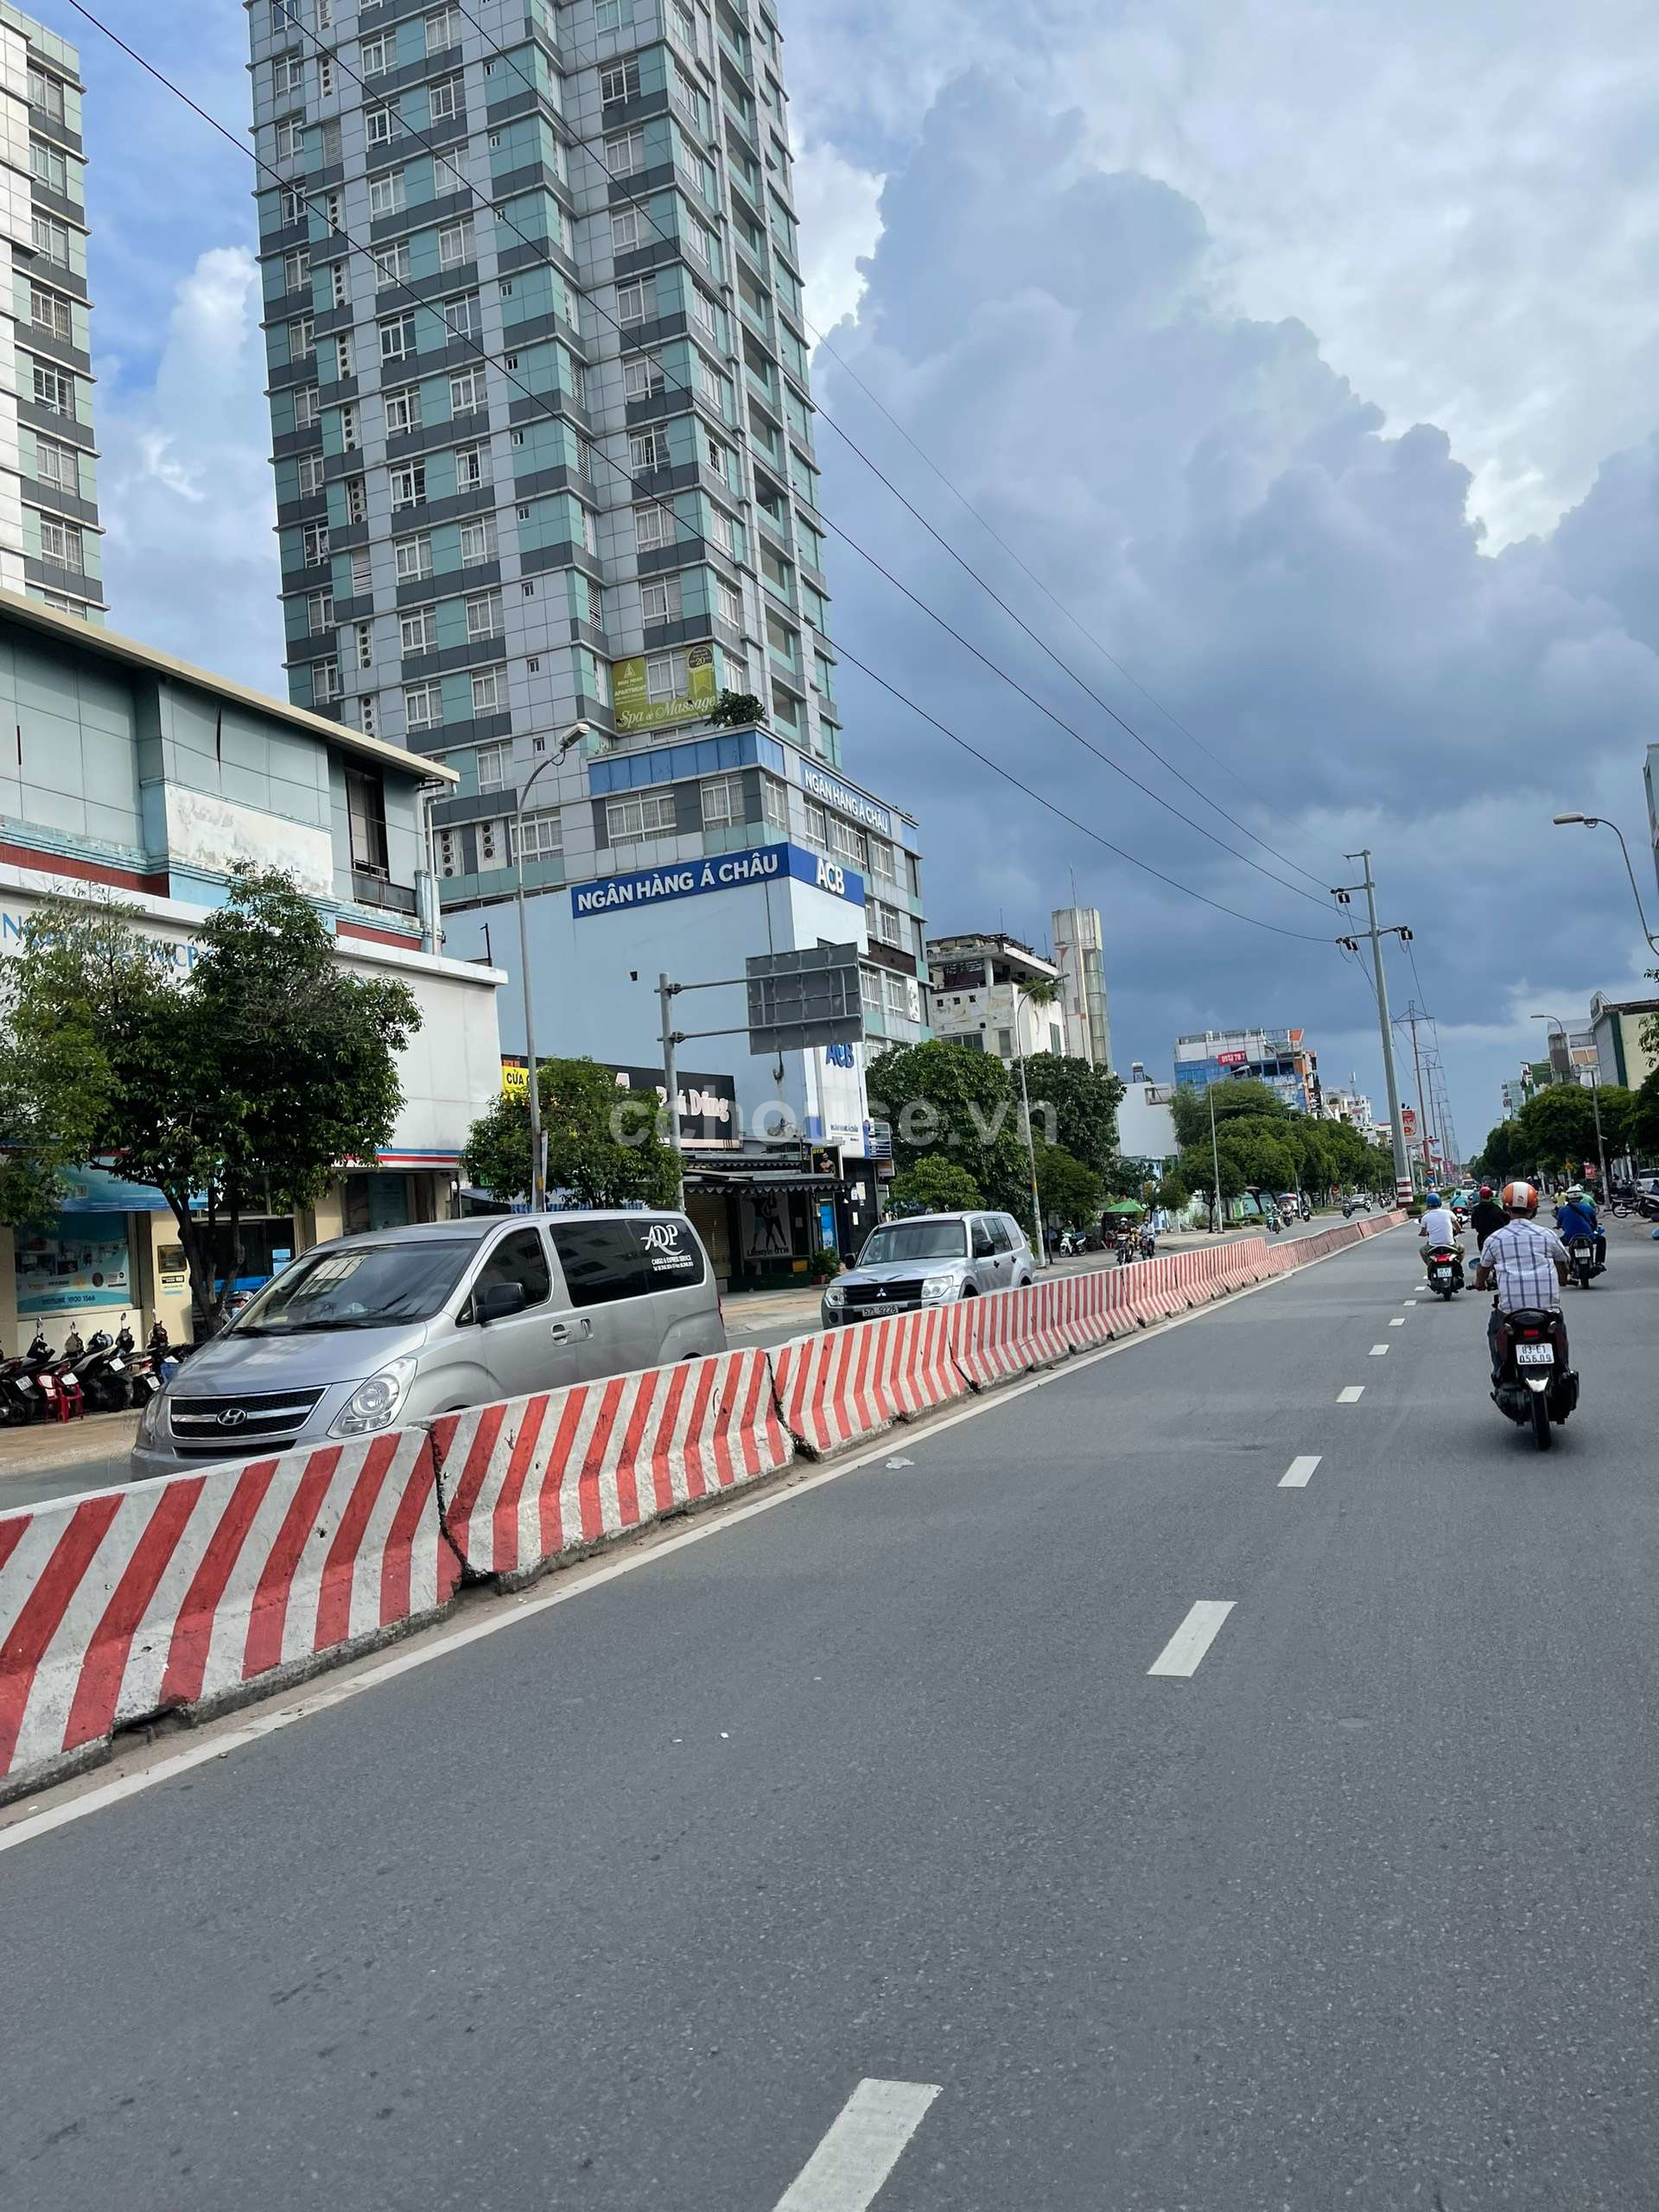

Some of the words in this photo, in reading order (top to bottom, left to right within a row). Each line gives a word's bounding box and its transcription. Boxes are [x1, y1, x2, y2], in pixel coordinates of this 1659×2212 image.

[617, 709, 645, 728] Spa
[656, 695, 717, 716] Massage
[804, 769, 832, 801] NGÂN
[833, 785, 858, 814] HÀNG
[859, 799, 865, 817] Á
[865, 807, 888, 833] CHÂU
[577, 882, 633, 911] NGÂN
[637, 873, 693, 899] HÀNG
[700, 862, 715, 887] Á
[719, 852, 779, 882] CHÂU
[816, 857, 845, 894] ACB
[826, 1044, 855, 1069] ACB
[506, 1069, 524, 1085] CỬA
[640, 1224, 681, 1253] ADP
